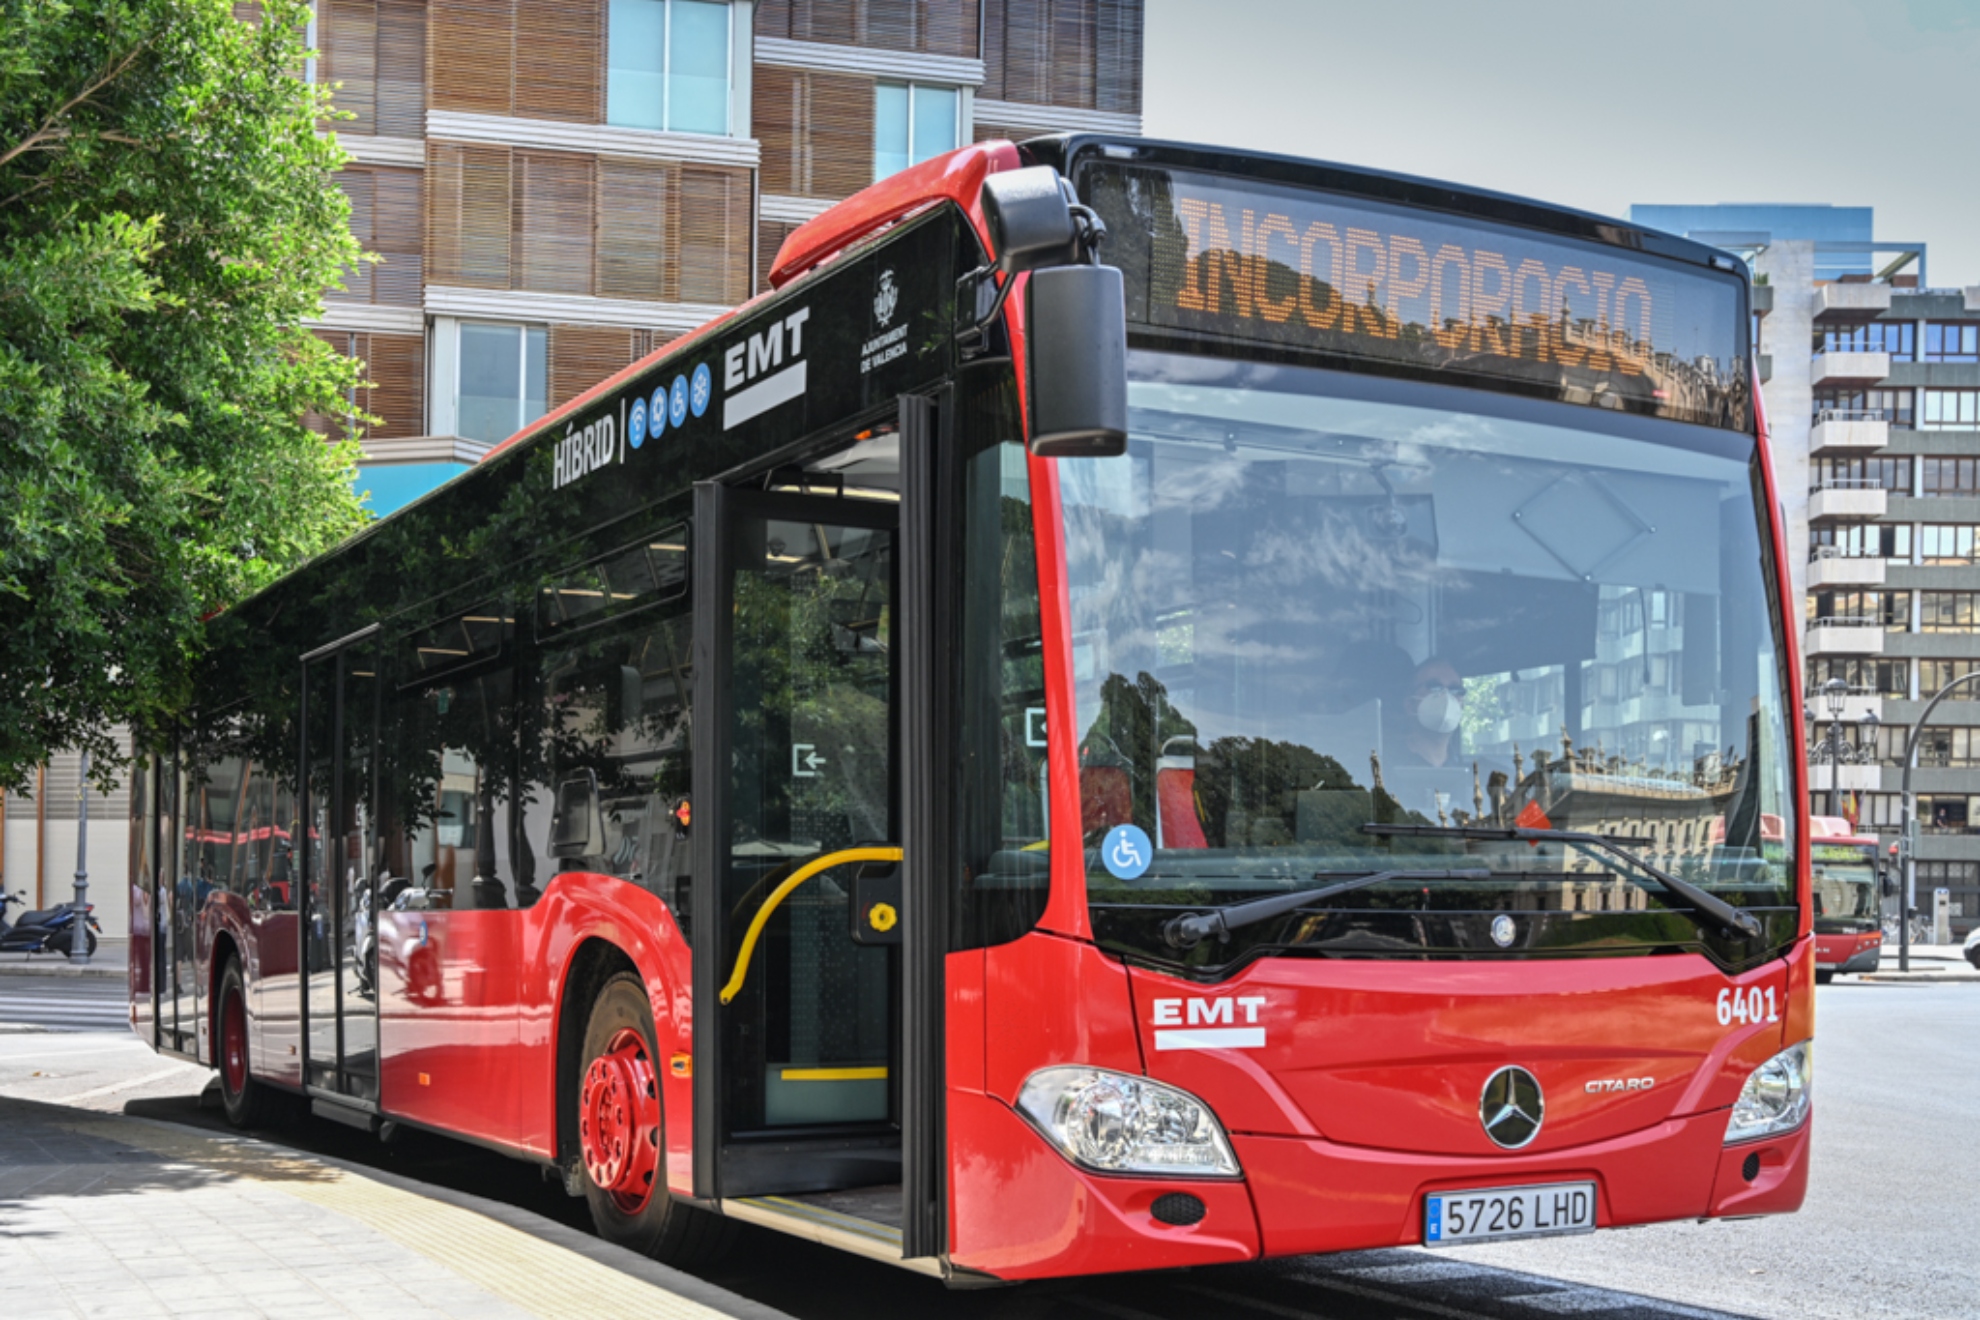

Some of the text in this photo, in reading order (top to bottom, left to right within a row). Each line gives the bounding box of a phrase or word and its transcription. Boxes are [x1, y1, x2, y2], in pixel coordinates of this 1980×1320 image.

[1177, 198, 1652, 376] INCORPORACIO
[724, 305, 810, 391] EMT
[861, 323, 908, 357] AJUNTAMENT
[860, 357, 871, 373] DE
[553, 414, 615, 490] HÍBRID
[1153, 996, 1266, 1026] EMT
[1716, 986, 1778, 1025] 6401
[1584, 1076, 1656, 1094] CITARO
[1430, 1222, 1438, 1234] E
[1448, 1190, 1587, 1234] 5726 LHD
